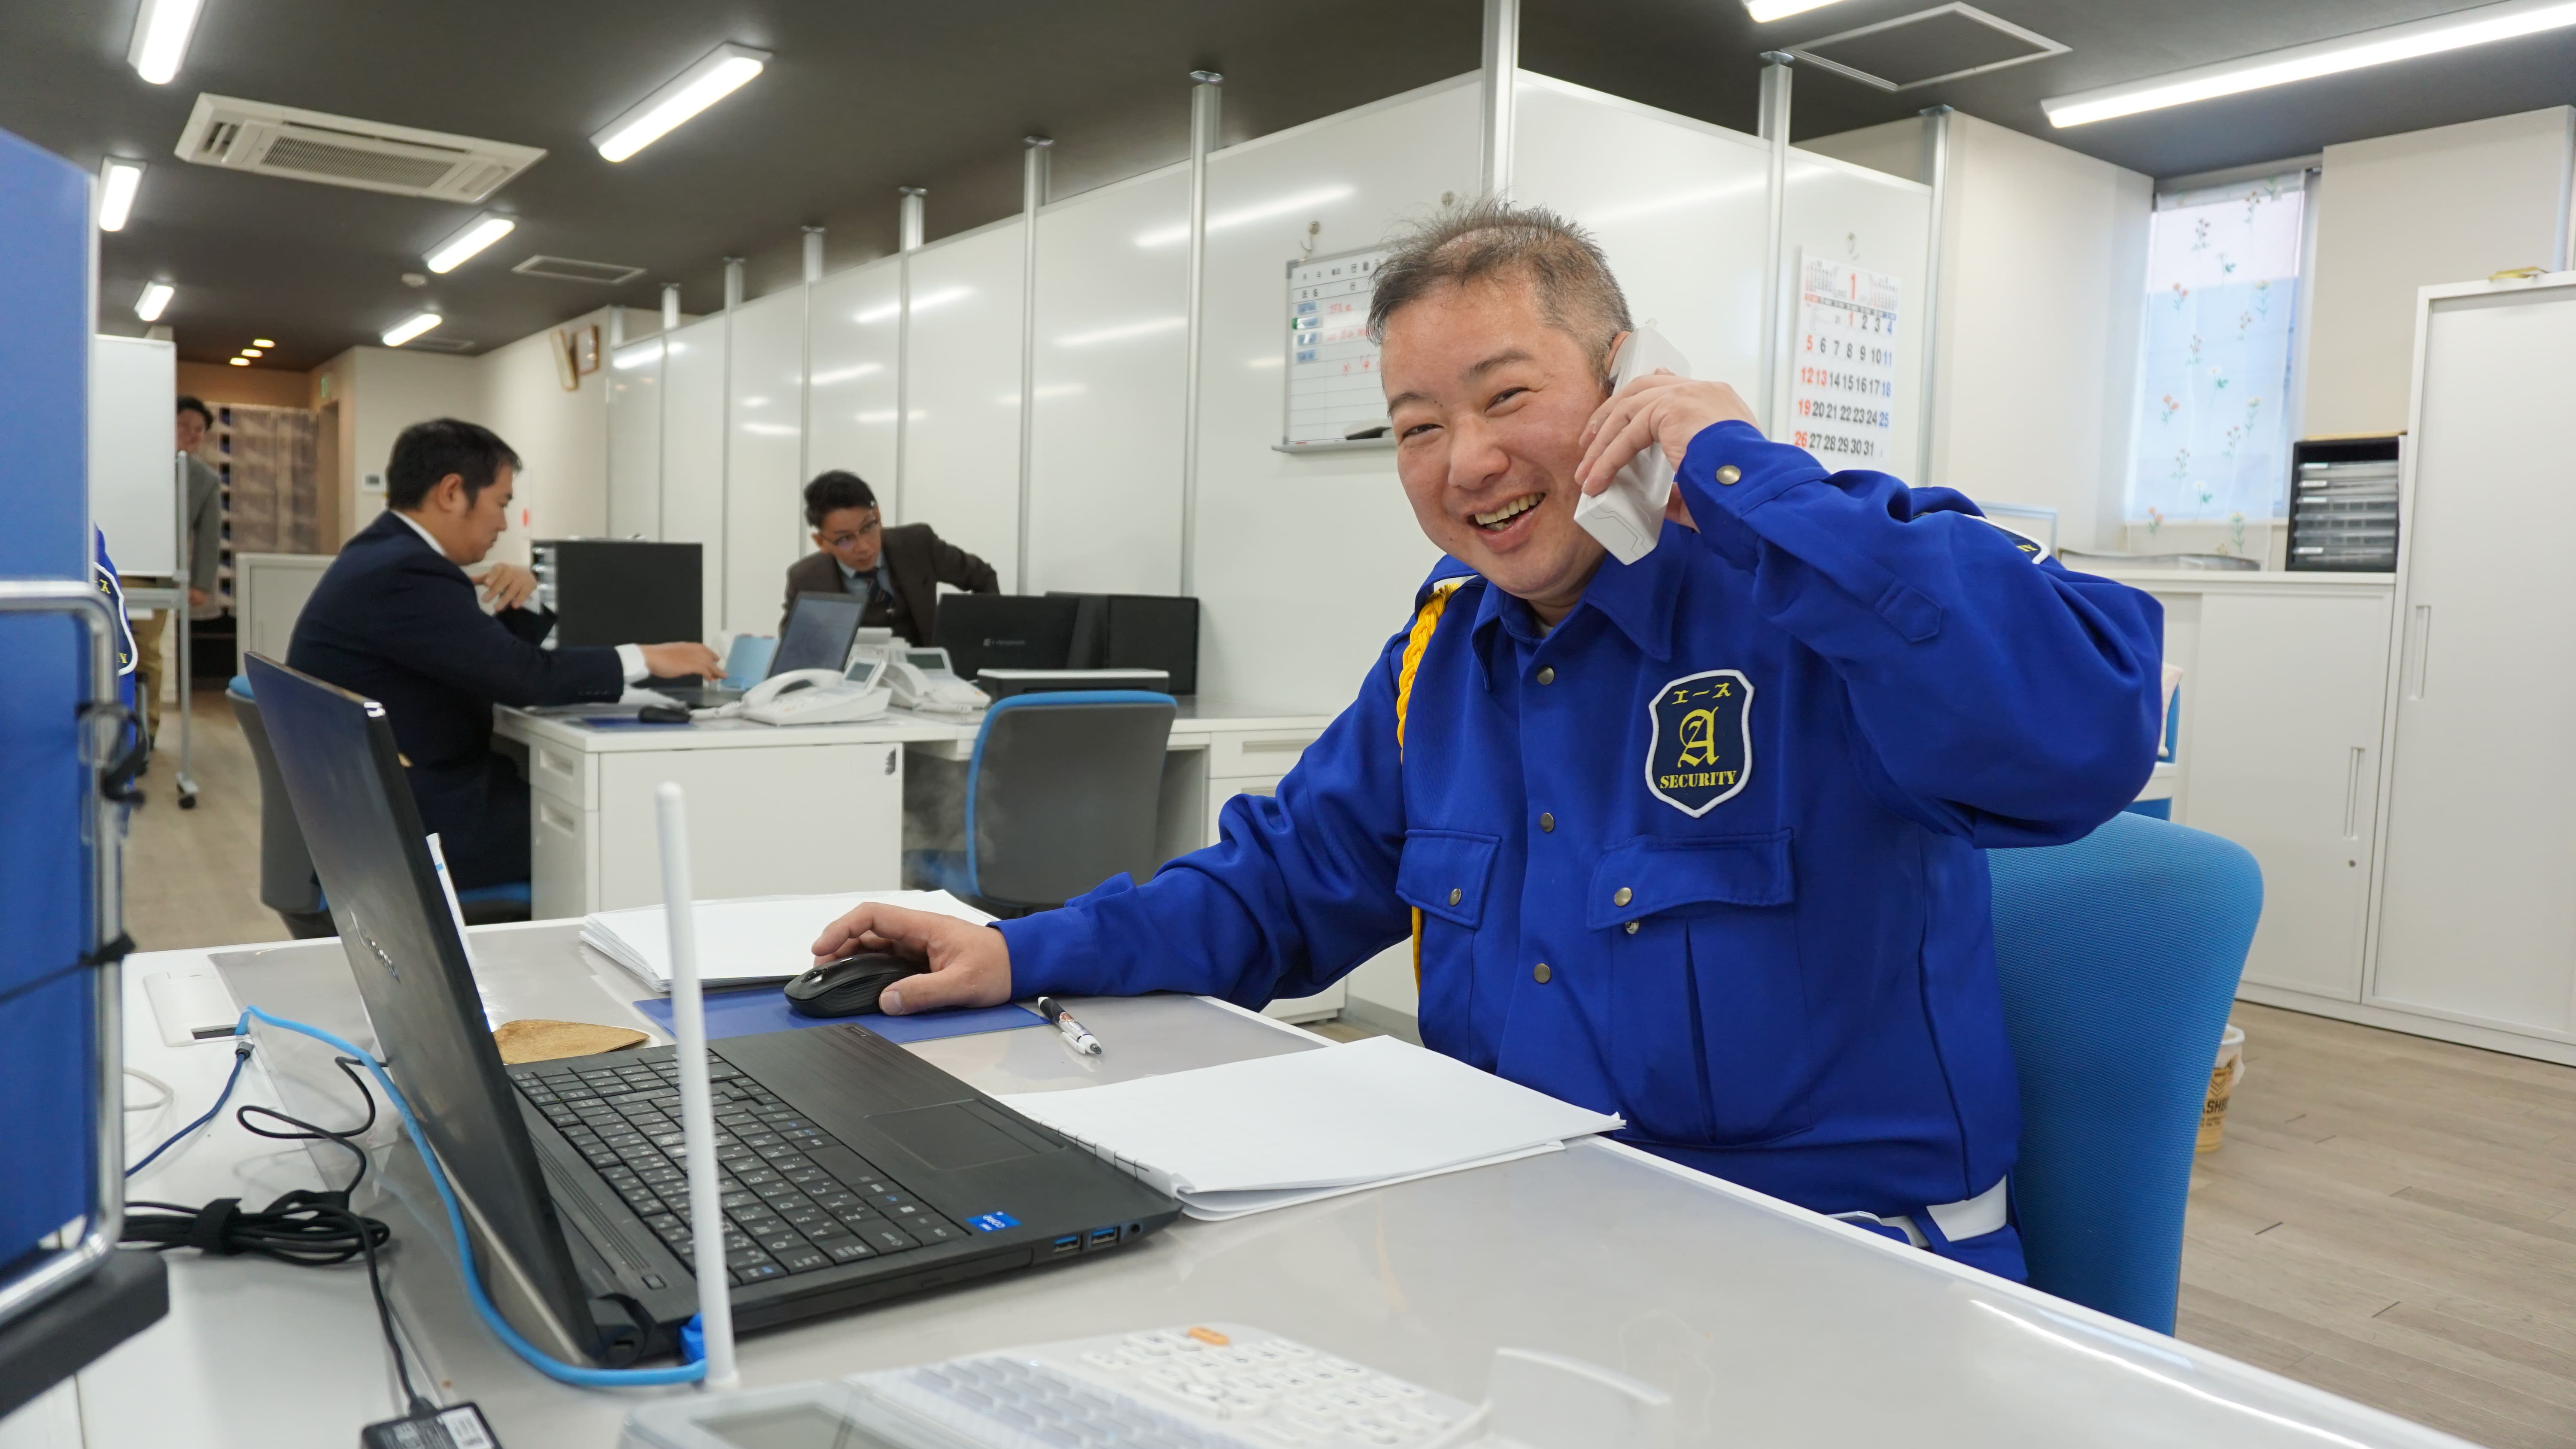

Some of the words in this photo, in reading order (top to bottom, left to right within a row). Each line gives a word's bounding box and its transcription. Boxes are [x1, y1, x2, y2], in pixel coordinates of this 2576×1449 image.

[1851, 274, 1856, 299] 1
[1850, 312, 1853, 326] 1
[1862, 314, 1868, 330] 2
[1875, 317, 1880, 333] 3
[1887, 320, 1892, 334] 4
[1807, 335, 1812, 350] 5
[1820, 337, 1826, 353] 6
[1834, 340, 1840, 355] 7
[1847, 343, 1852, 358] 8
[1860, 346, 1865, 361] 9
[1871, 349, 1881, 364] 10
[1884, 351, 1892, 366] 11
[1801, 368, 1814, 383] 12
[1816, 370, 1827, 386] 13
[1830, 373, 1840, 387] 14
[1843, 375, 1853, 391] 15
[1856, 377, 1866, 393] 16
[1870, 379, 1880, 394] 17
[1882, 382, 1890, 397] 18
[1799, 400, 1810, 415] 19
[1813, 401, 1824, 418] 20
[1826, 403, 1837, 419] 21
[1840, 406, 1852, 421] 22
[1853, 408, 1865, 423] 23
[1866, 410, 1877, 425] 24
[1879, 412, 1888, 427] 25
[1794, 432, 1807, 448] 26
[1809, 433, 1822, 448] 27
[1823, 435, 1836, 451] 28
[1837, 437, 1848, 453] 29
[1850, 439, 1862, 455] 30
[1863, 440, 1874, 456] 31
[1671, 682, 1732, 705] エース
[1677, 706, 1719, 768] A
[1659, 770, 1738, 789] SECURITY
